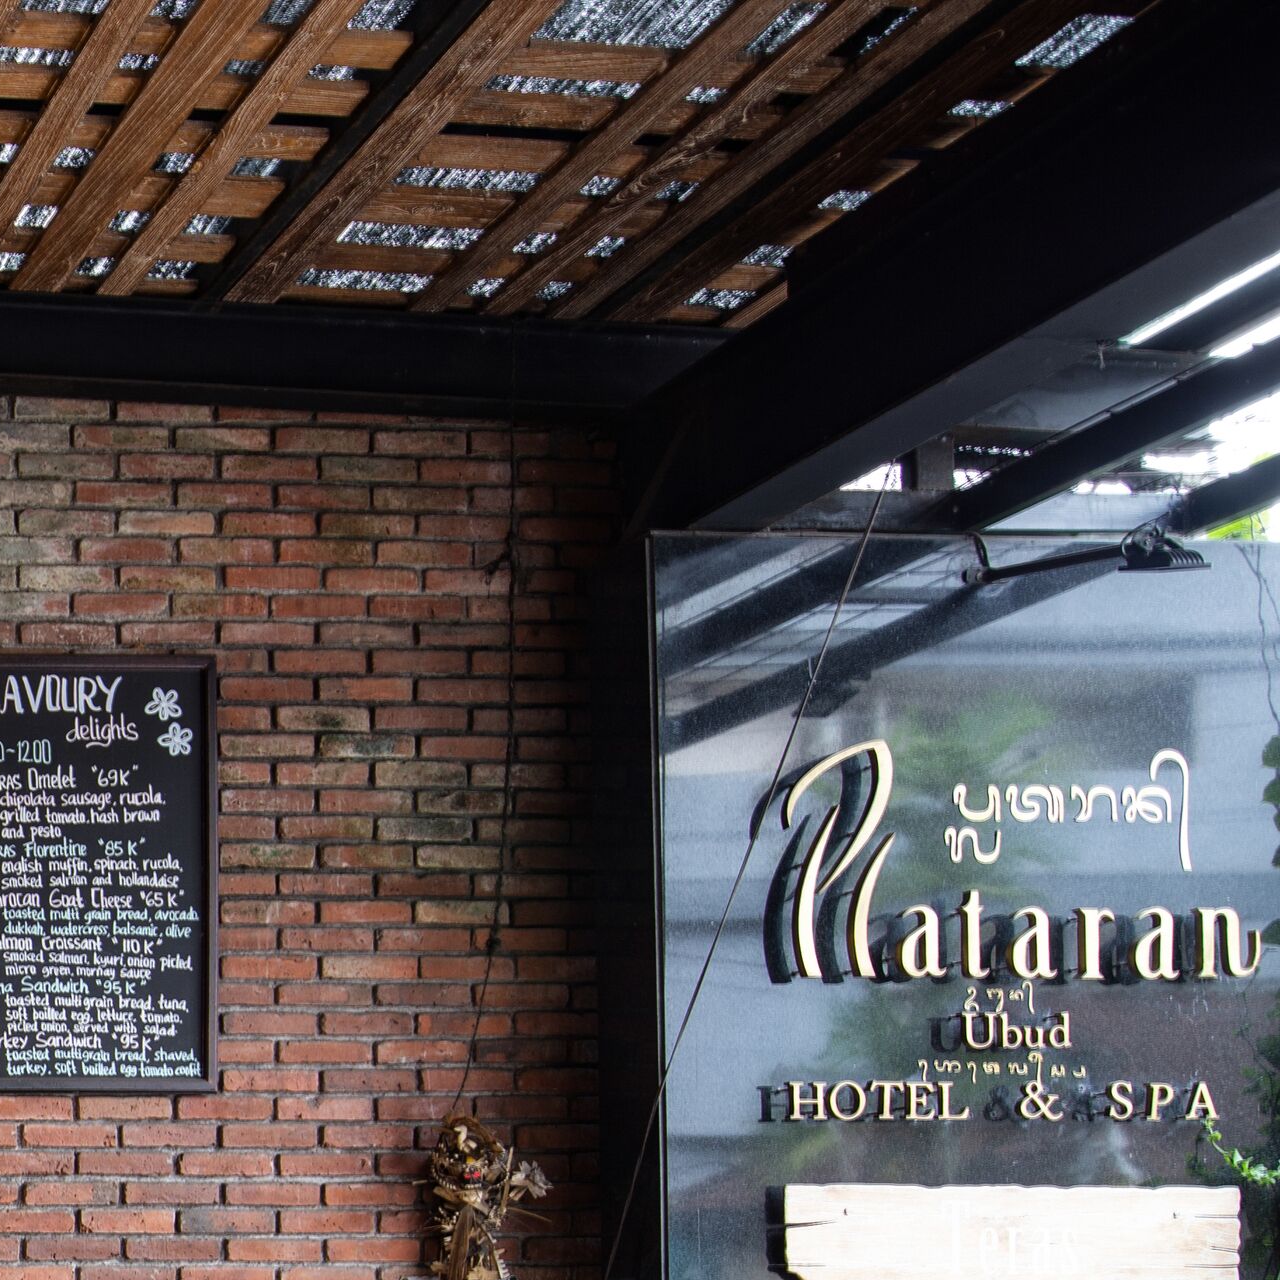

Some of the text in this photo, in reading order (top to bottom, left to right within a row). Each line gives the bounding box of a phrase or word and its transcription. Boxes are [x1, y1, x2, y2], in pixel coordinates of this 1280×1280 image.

[66, 713, 138, 748] delights
[28, 764, 77, 791] Omelet
[0, 790, 55, 810] chipolata
[0, 806, 40, 826] grilled
[91, 808, 119, 824] hash
[123, 807, 160, 824] brown
[1, 824, 62, 842] and pesto
[23, 836, 87, 858] Florentine
[1, 856, 42, 875] english
[1, 874, 43, 890] smoked
[49, 872, 87, 887] salmon
[49, 887, 85, 908] Goat
[91, 887, 132, 908] Cheese
[2, 906, 46, 921] toasted
[41, 935, 102, 951] Croissant
[21, 975, 89, 994] Sandwich
[35, 1031, 102, 1049] Sandwich
[962, 1012, 1071, 1049] Ubud
[788, 1081, 1219, 1122] HOTEL & SPA
